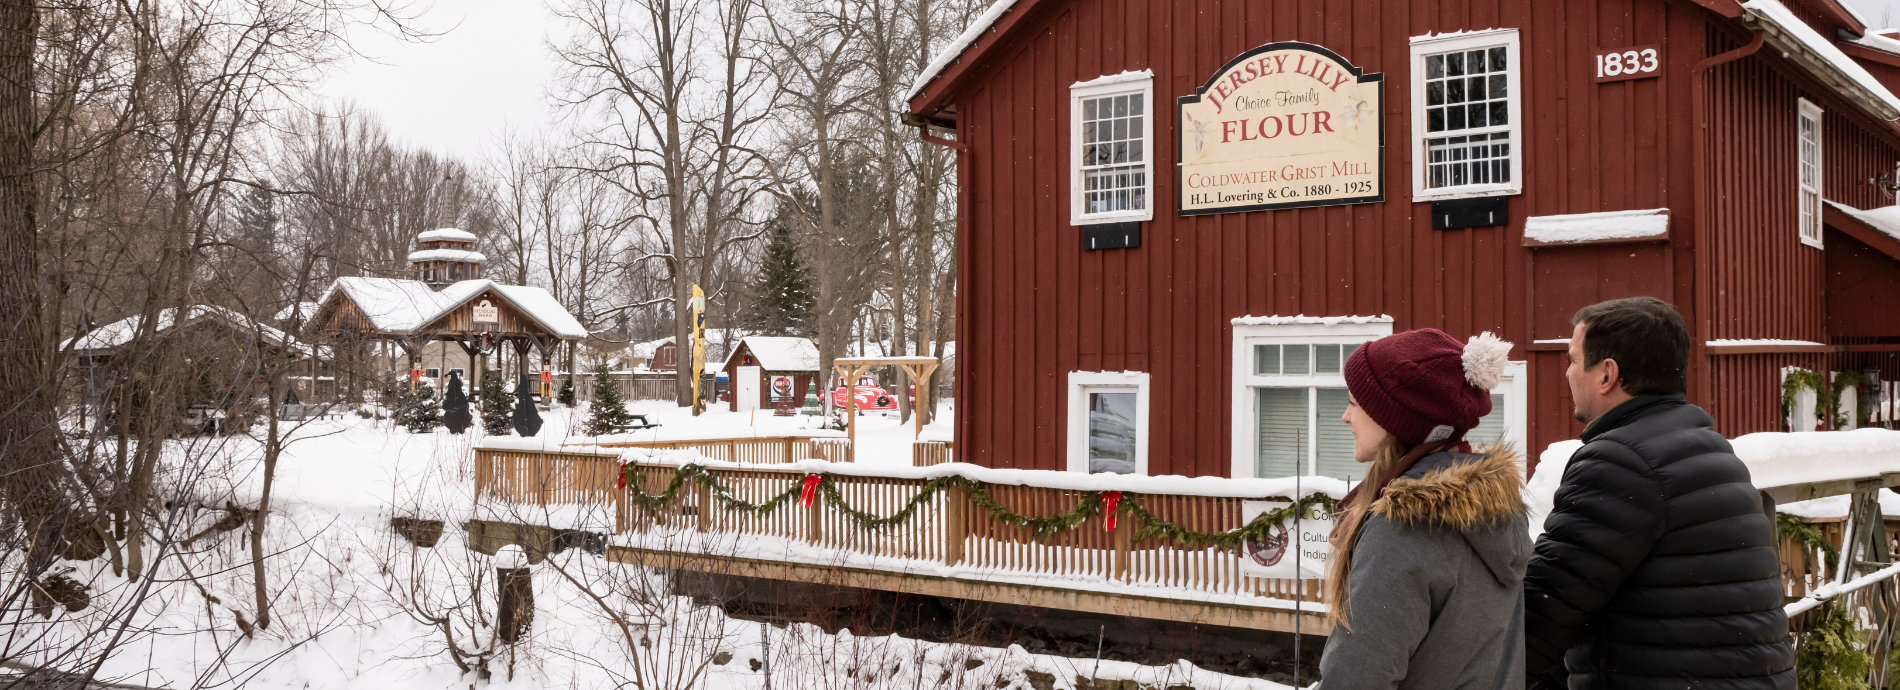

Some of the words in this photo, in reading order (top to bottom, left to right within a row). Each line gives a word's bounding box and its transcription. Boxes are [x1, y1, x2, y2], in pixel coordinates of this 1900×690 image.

[1597, 48, 1658, 77] 1833
[1206, 53, 1290, 114] JERSEY
[1294, 53, 1350, 93] LILY
[1235, 95, 1271, 111] Choice
[1275, 88, 1320, 106] Family
[1221, 110, 1334, 143] FLOUR
[1190, 193, 1214, 205] H.L.
[1217, 190, 1264, 203] Lovering
[1267, 188, 1278, 199] &
[1280, 187, 1300, 198] Co.
[1304, 184, 1331, 197] 1880
[1344, 181, 1372, 194] 1925
